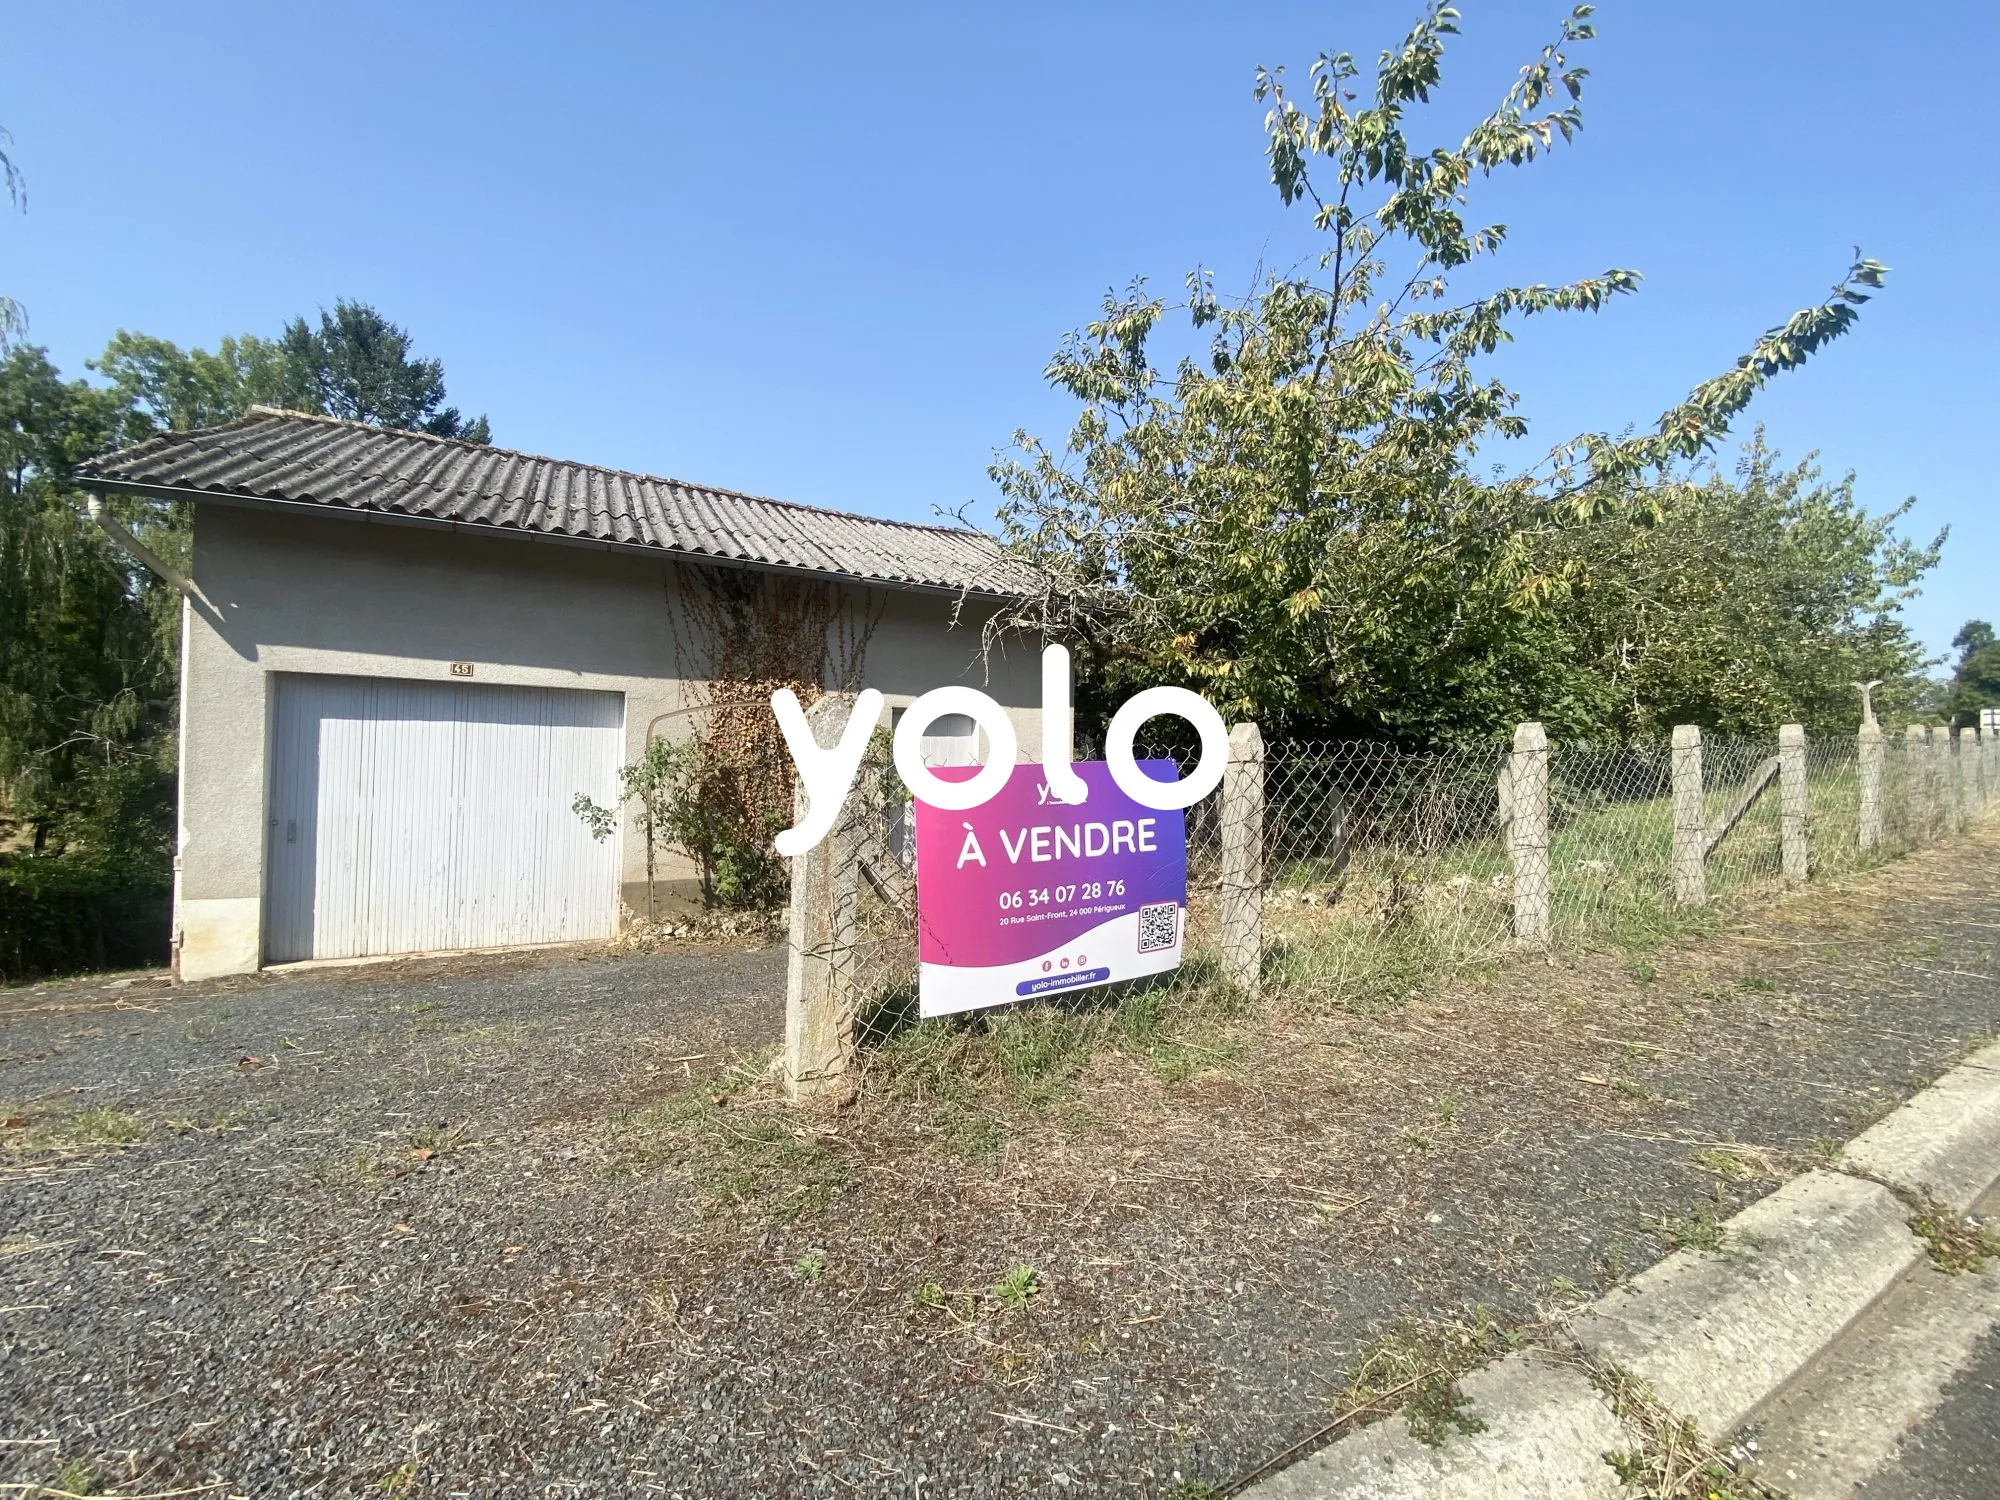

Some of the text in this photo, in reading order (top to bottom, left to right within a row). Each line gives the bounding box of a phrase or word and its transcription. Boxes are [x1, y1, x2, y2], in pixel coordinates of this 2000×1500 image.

[454, 664, 469, 674] 45
[956, 818, 1158, 869] À VENDRE
[999, 879, 1126, 910] 06 34 07 28 76
[999, 903, 1126, 926] 20 Rue Saint-Front, 24 000 Périgueux
[1031, 971, 1097, 992] yolo-immobilier.fr
